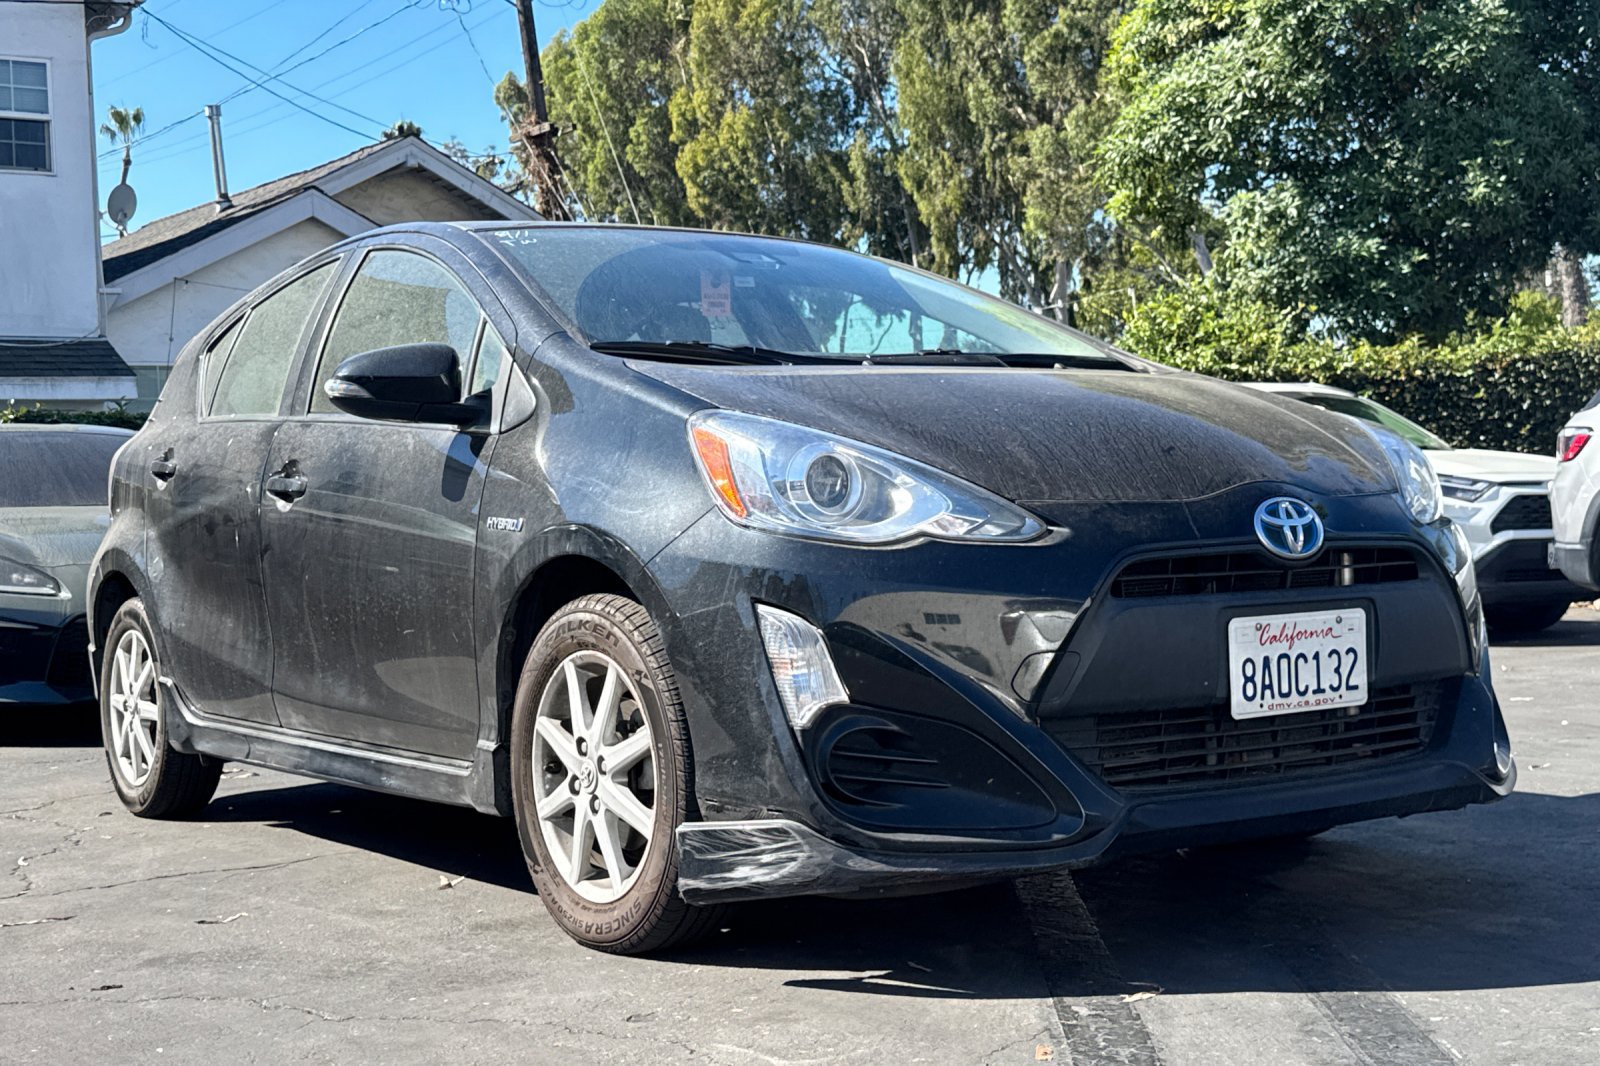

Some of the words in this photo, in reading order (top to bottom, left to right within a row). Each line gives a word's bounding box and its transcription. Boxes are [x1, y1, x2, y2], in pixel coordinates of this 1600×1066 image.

[487, 517, 517, 531] HYBRID
[1259, 622, 1342, 651] California
[1268, 696, 1335, 711] dmv.ca.gov
[557, 905, 584, 929] SN250
[584, 897, 642, 935] SINCERA
